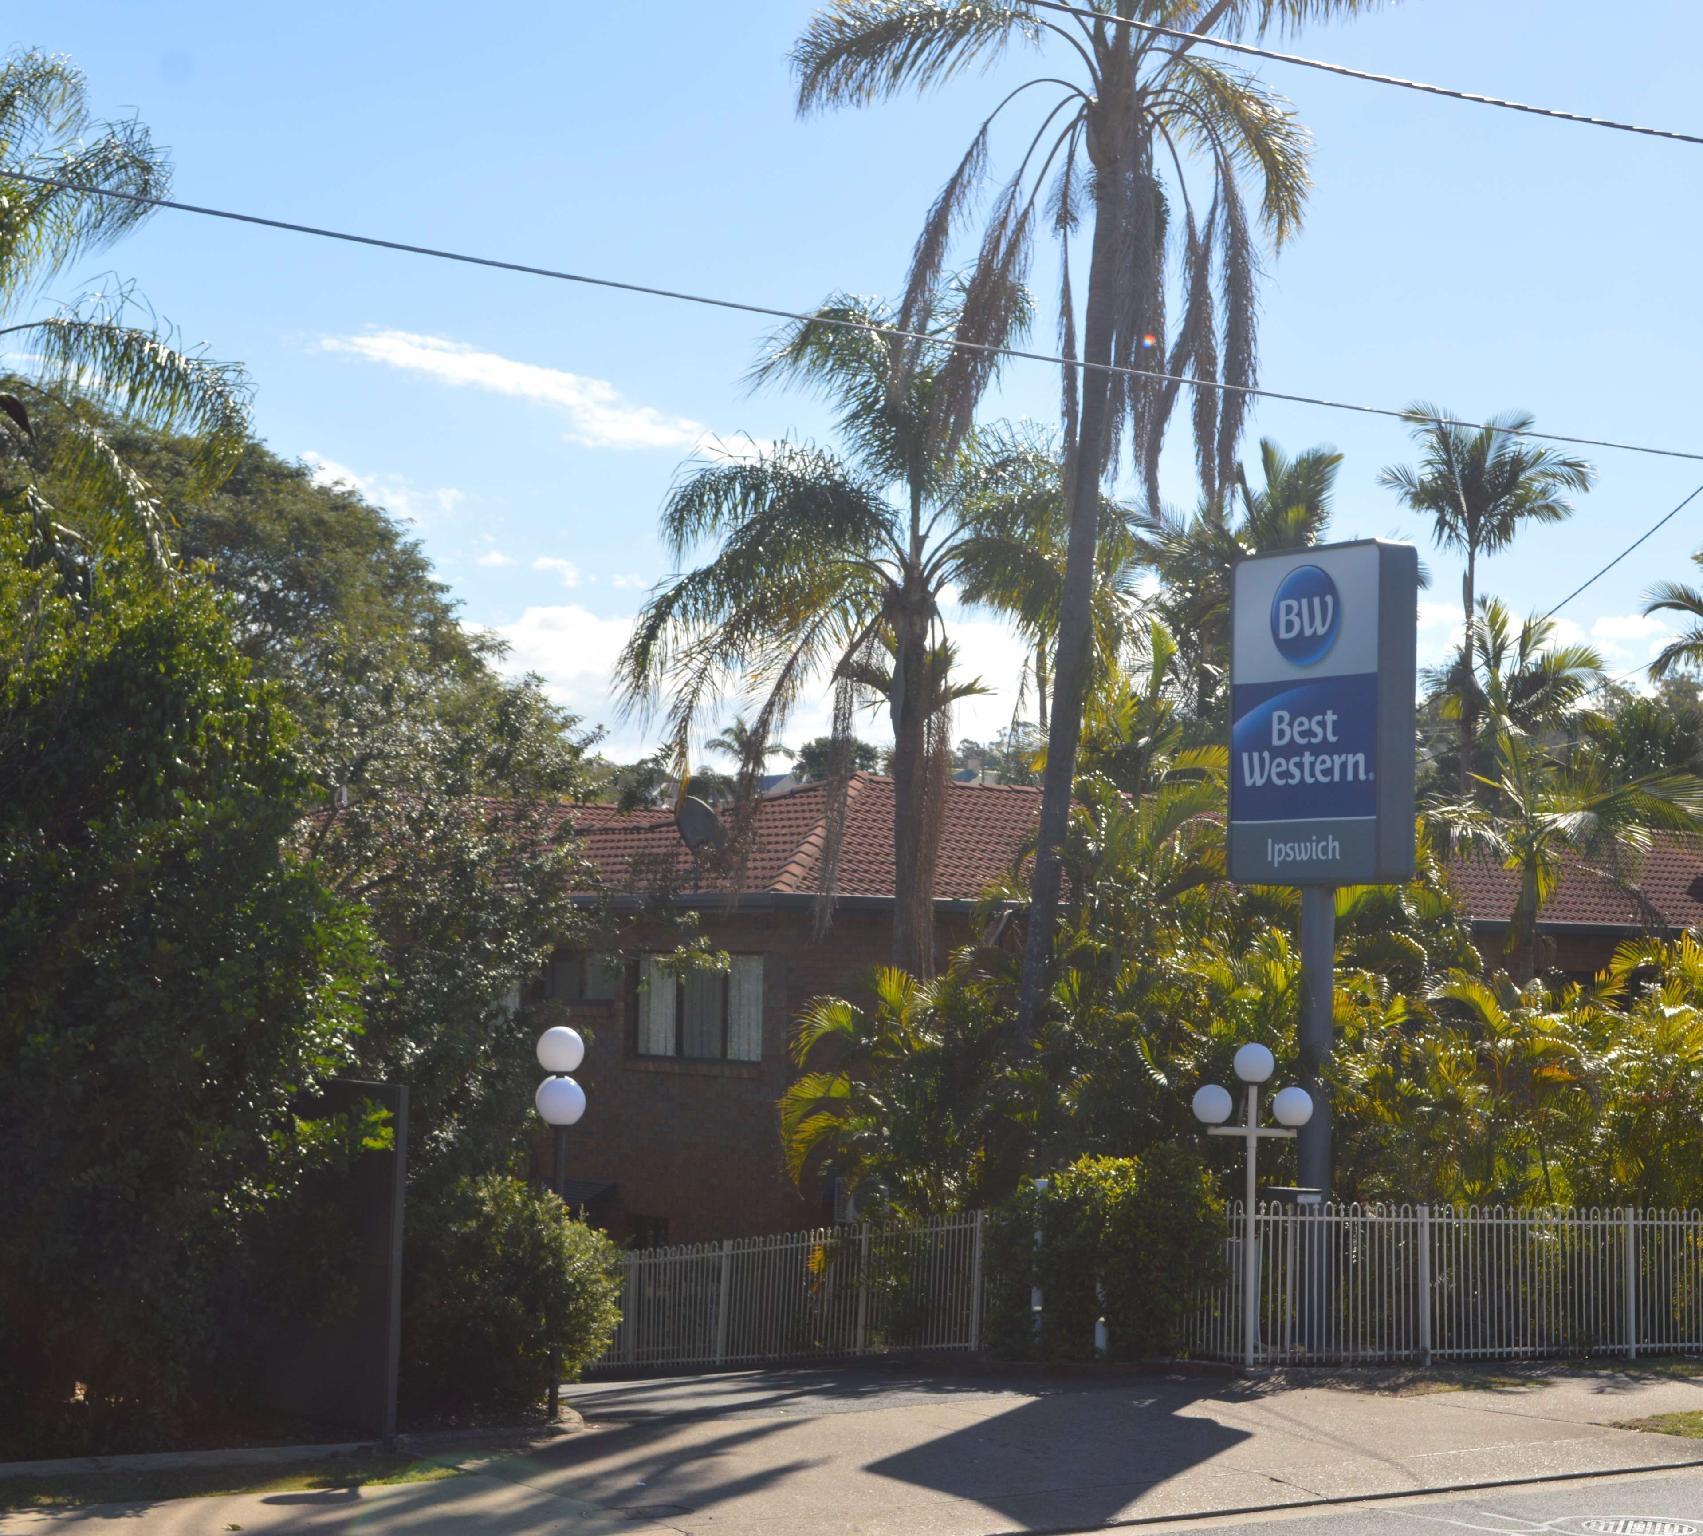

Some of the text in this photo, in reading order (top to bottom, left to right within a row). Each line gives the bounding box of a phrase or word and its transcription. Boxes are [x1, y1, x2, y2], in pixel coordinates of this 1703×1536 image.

[1278, 595, 1333, 640] BW
[1271, 710, 1338, 746] Best
[1267, 835, 1340, 867] Ipswich
